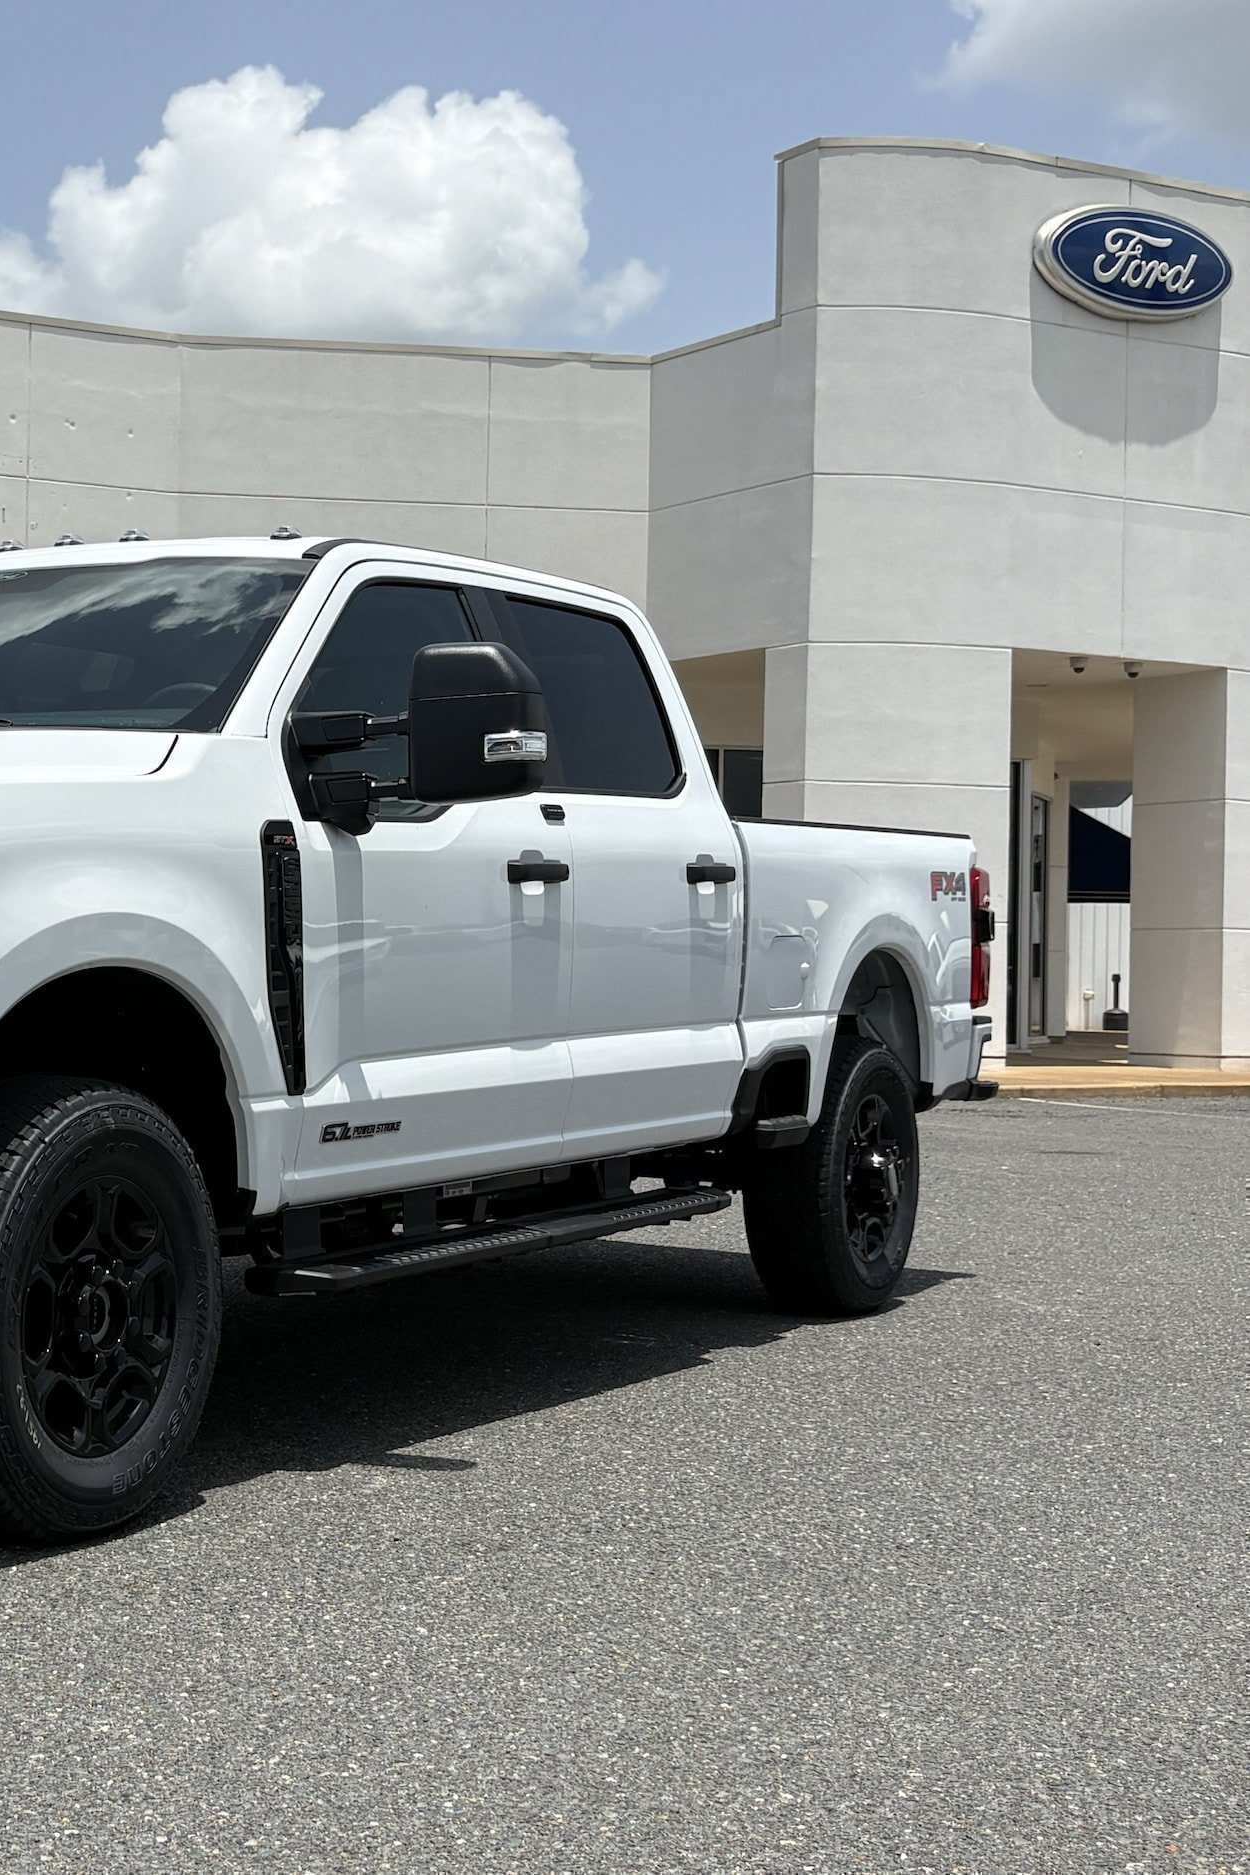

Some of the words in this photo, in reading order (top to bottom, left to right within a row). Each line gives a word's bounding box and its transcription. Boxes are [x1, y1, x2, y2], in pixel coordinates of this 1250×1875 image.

[1093, 228, 1198, 294] Ford
[930, 871, 966, 901] FX4
[353, 1125, 375, 1135] POWER
[112, 1246, 210, 1495] BRIDGESTONE
